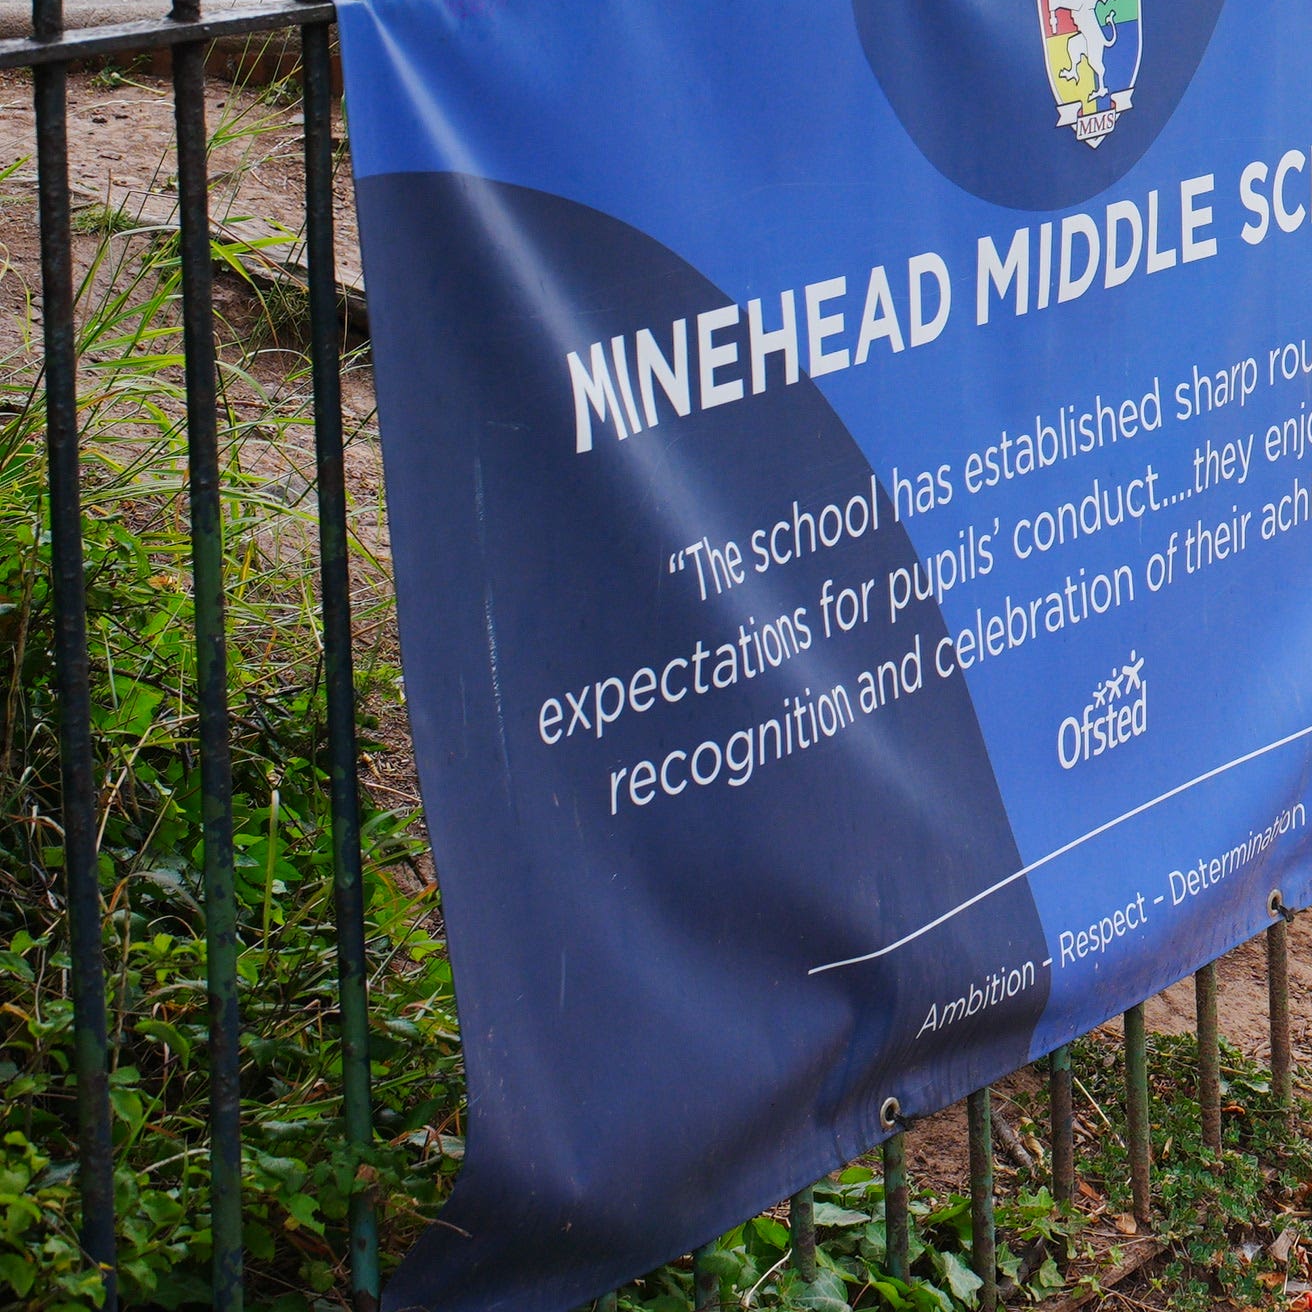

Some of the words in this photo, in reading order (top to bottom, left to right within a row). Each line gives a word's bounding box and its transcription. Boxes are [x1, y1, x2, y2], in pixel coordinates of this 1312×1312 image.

[1079, 112, 1115, 137] MMS
[567, 252, 952, 454] MINEHEAD
[976, 173, 1218, 326] MIDDLE
[751, 474, 879, 572] school
[892, 463, 953, 522] has
[964, 376, 1162, 494] established
[1175, 357, 1258, 421] sharp
[538, 606, 811, 745] expectations
[820, 578, 875, 638] for
[611, 683, 854, 815] recognition
[857, 634, 922, 714] and
[935, 565, 1134, 678] celebration
[1147, 532, 1177, 592] of
[1185, 505, 1251, 574] their
[1058, 680, 1147, 770] Ofsted
[916, 959, 1035, 1040] Ambition
[1059, 892, 1147, 968] Respect
[1168, 802, 1306, 906] Determination
